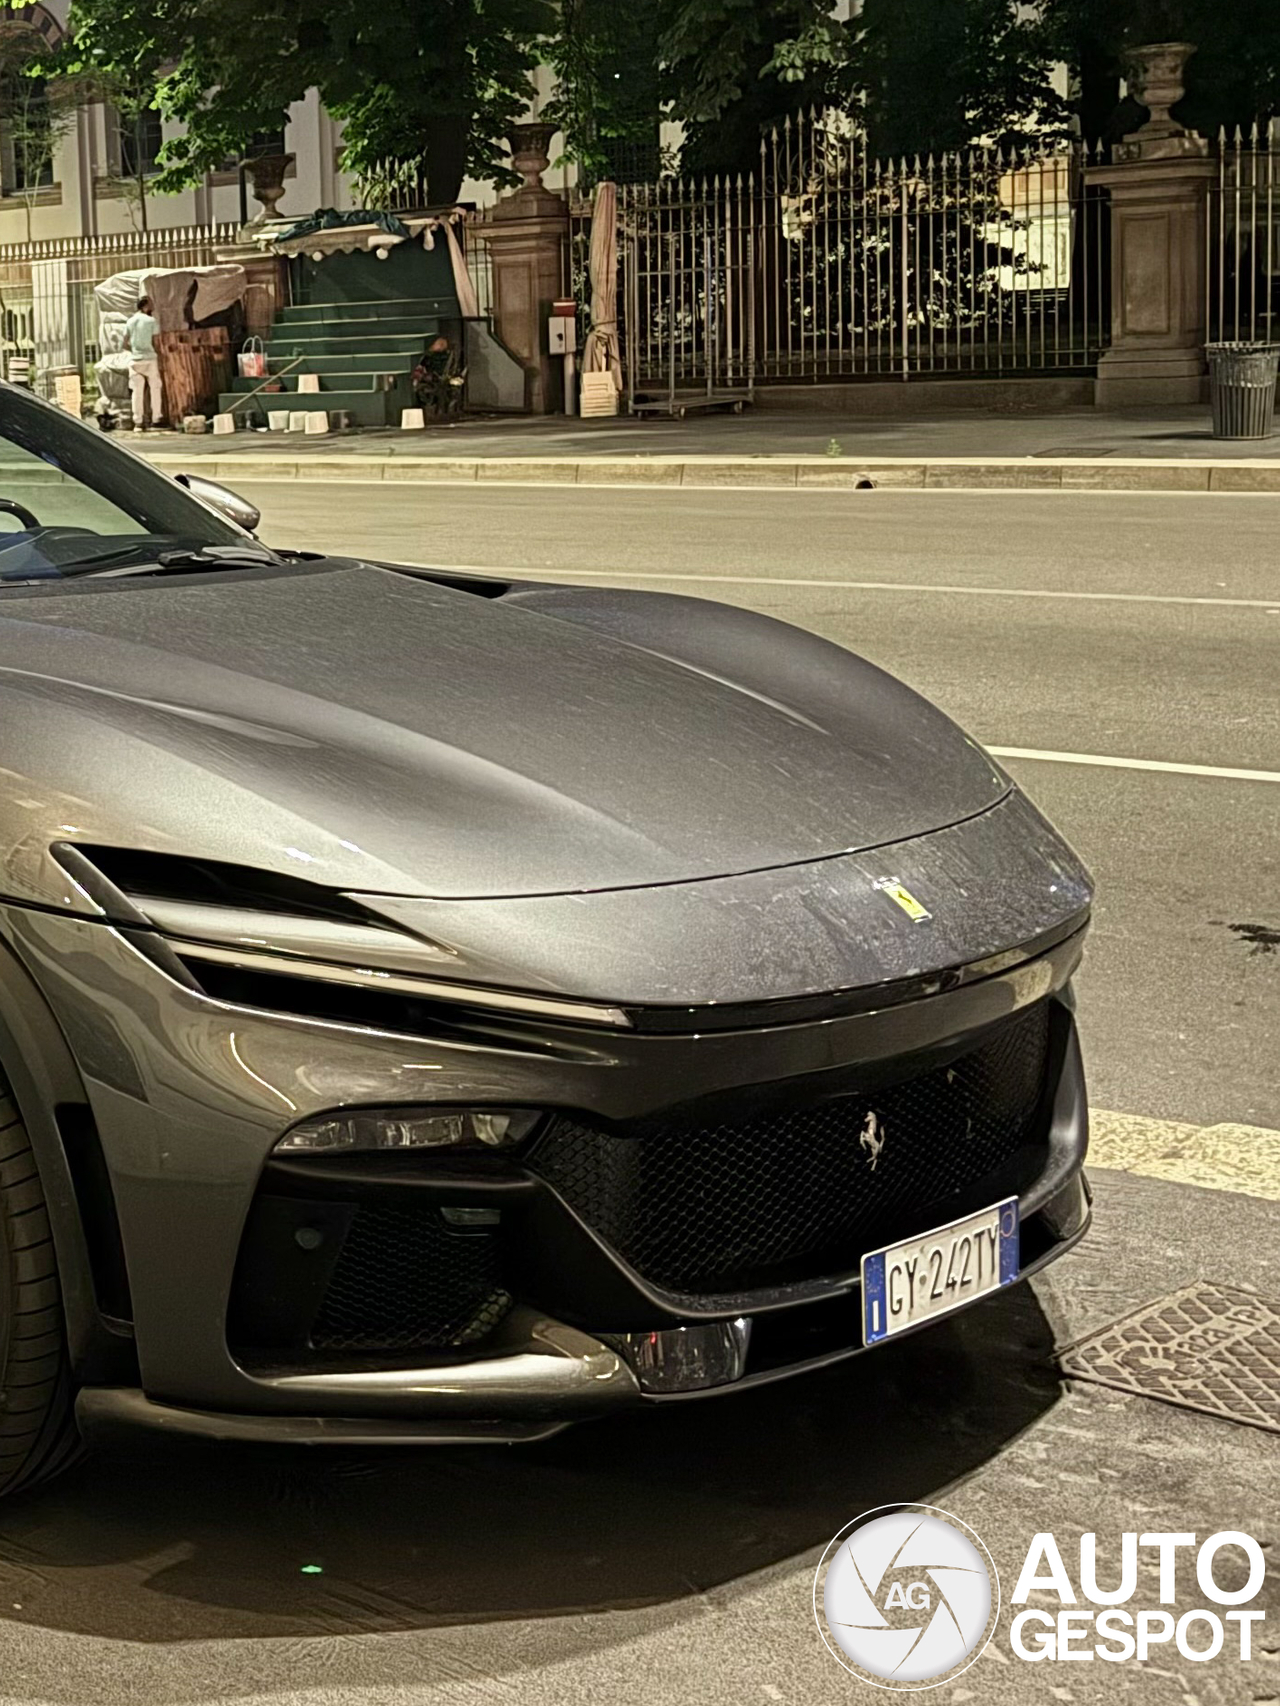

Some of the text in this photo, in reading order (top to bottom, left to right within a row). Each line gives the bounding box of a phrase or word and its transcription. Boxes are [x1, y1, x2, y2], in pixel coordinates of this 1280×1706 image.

[889, 1224, 999, 1315] GY 242TY
[872, 1300, 879, 1332] I
